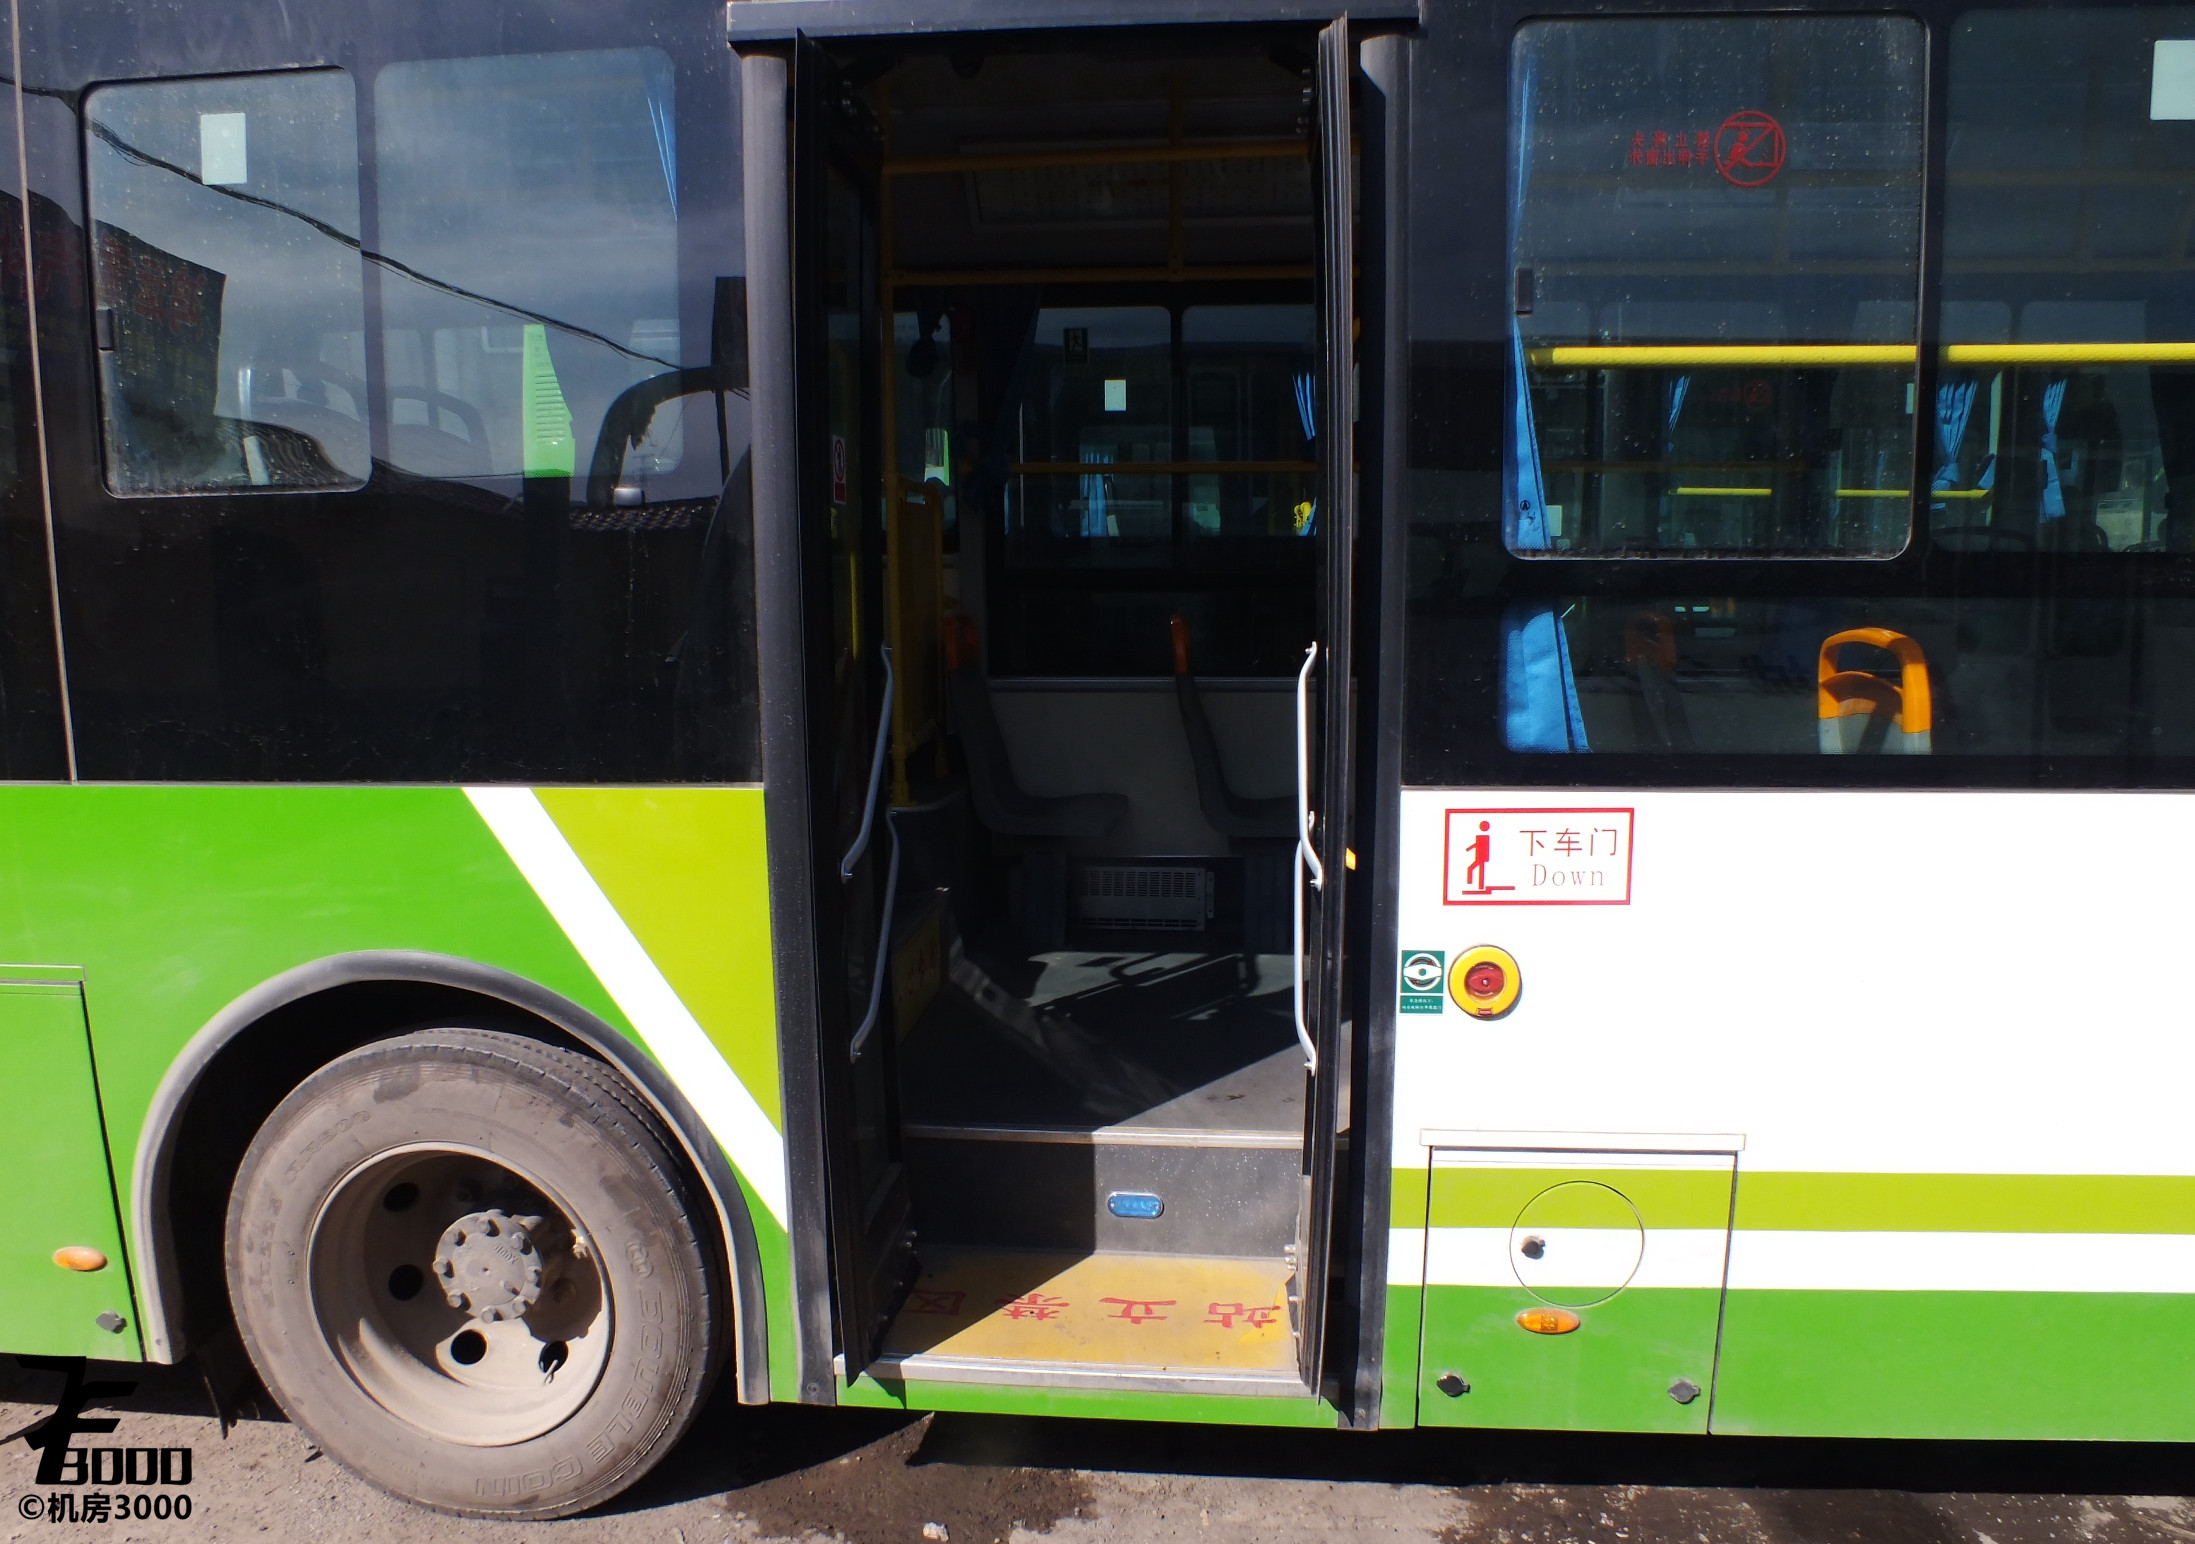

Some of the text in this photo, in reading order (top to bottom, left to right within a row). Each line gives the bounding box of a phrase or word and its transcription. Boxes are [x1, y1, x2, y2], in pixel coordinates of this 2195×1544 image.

[1519, 828, 1618, 857] 下车门
[1532, 863, 1605, 887] Down
